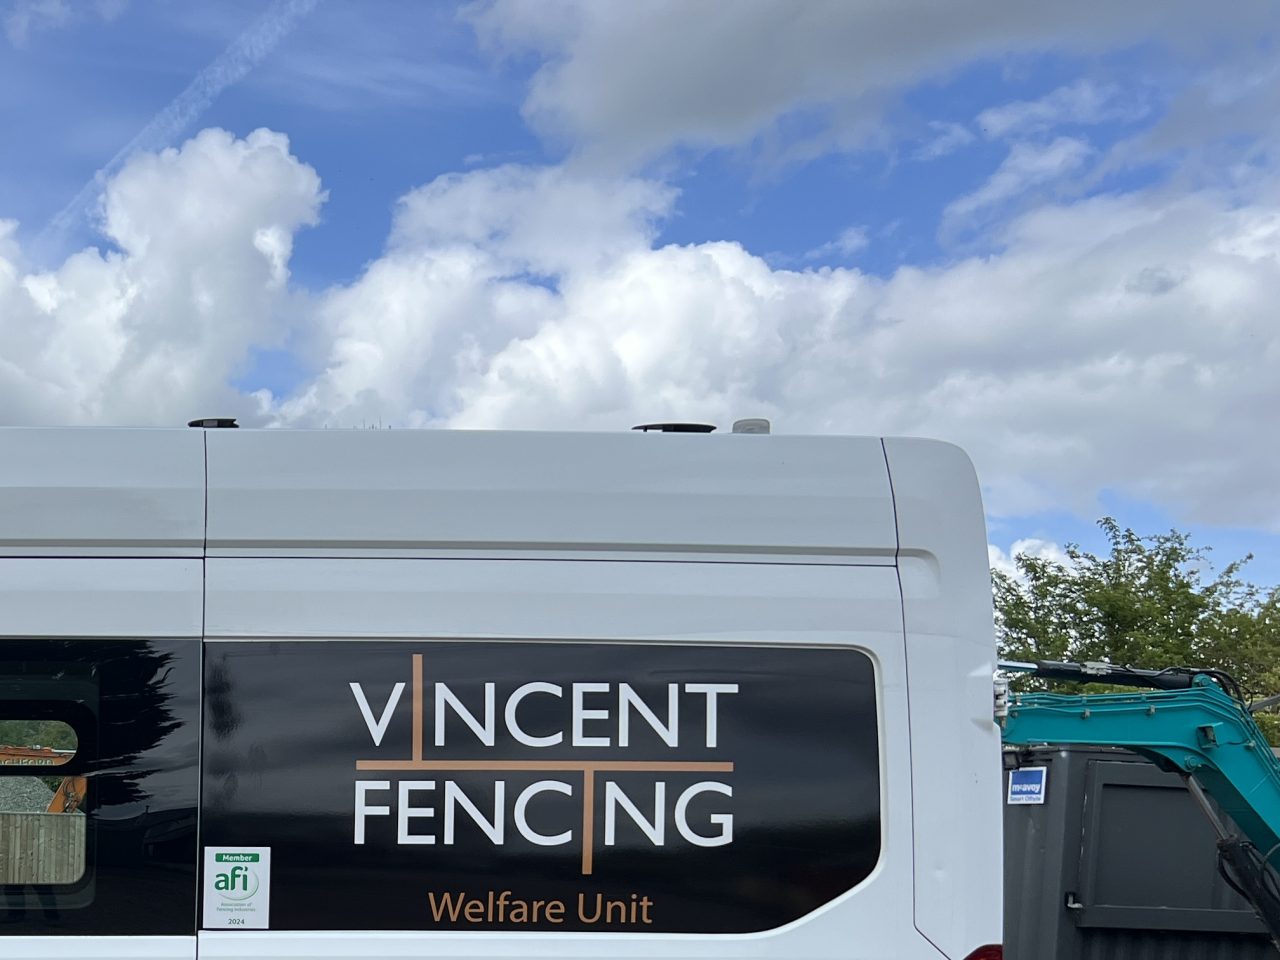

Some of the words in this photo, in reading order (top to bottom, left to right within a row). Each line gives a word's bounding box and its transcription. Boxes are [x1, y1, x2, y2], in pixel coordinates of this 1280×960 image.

[349, 654, 738, 754] VINCENT
[355, 779, 733, 874] FENCING
[222, 854, 253, 862] Member
[214, 866, 248, 891] afi
[429, 892, 565, 923] Welfare
[578, 894, 652, 924] Unit
